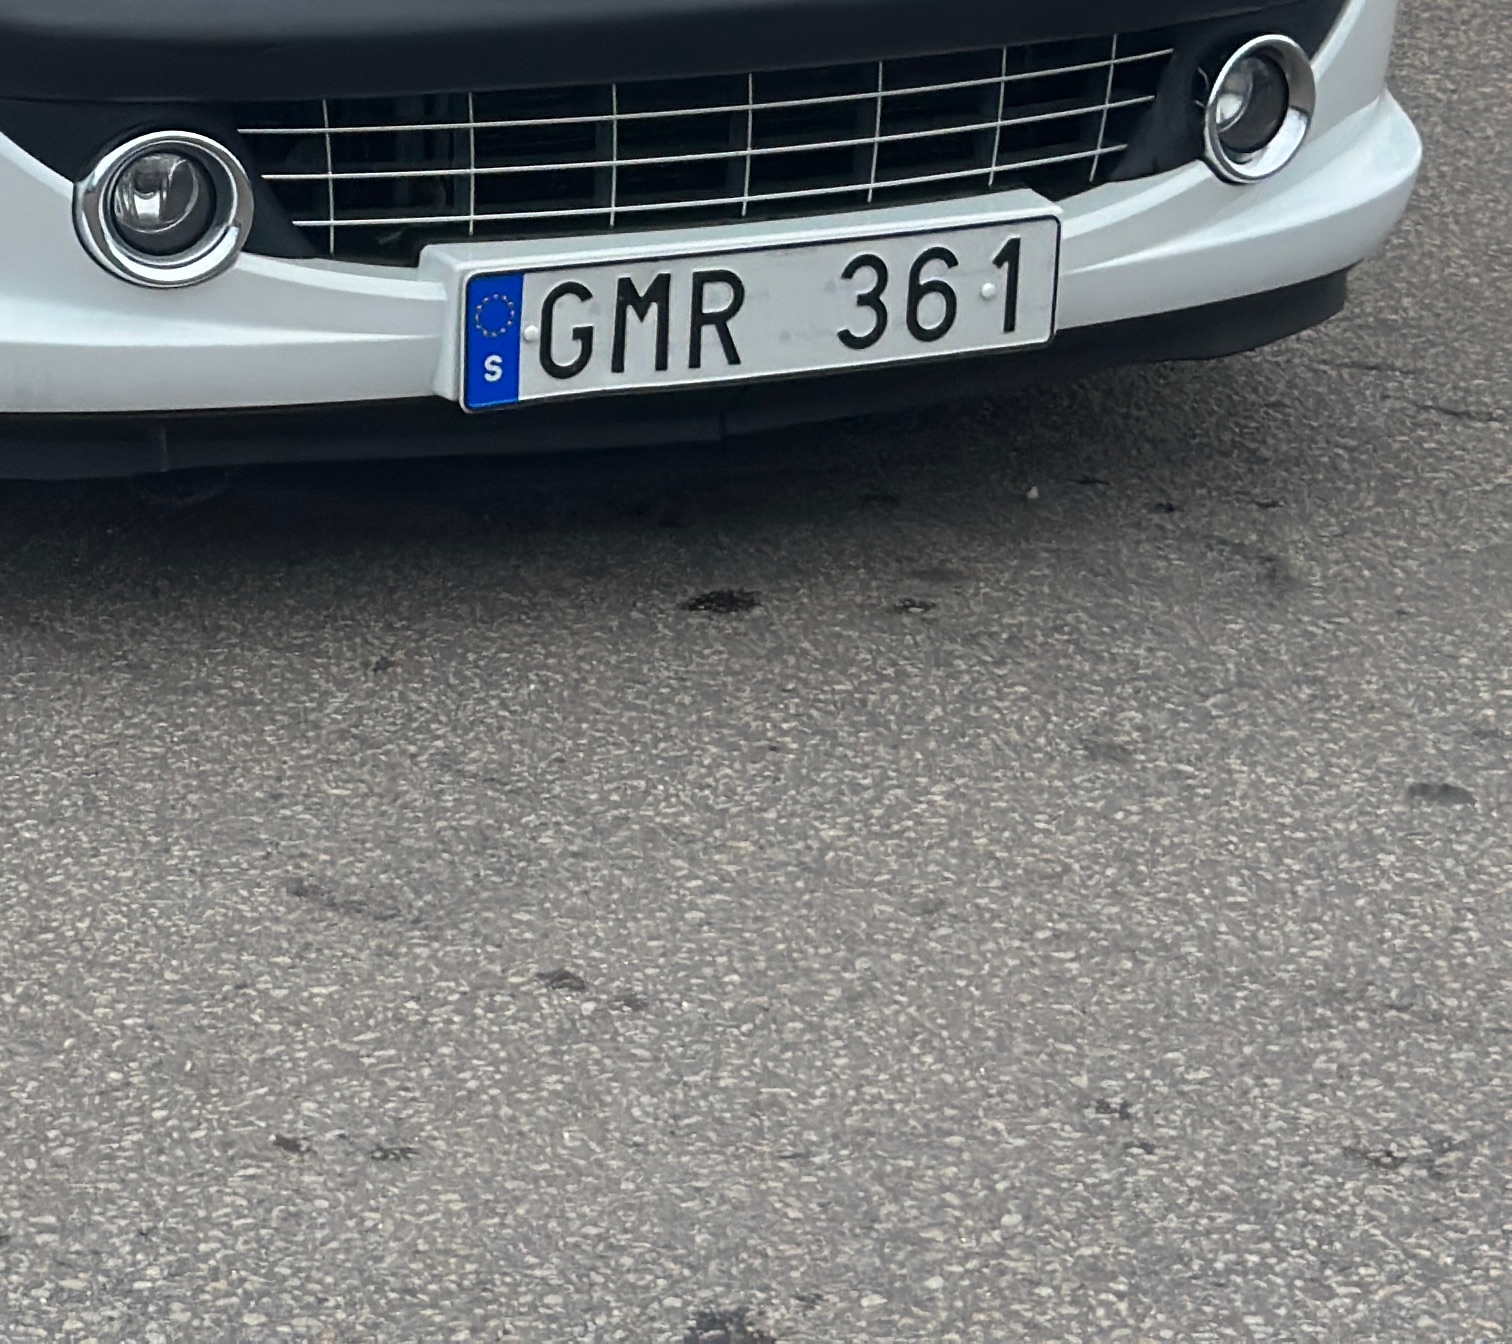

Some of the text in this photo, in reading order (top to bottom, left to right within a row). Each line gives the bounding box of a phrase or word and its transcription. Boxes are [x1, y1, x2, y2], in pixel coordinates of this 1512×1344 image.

[538, 236, 1023, 381] GMR 361
[483, 354, 504, 383] S
